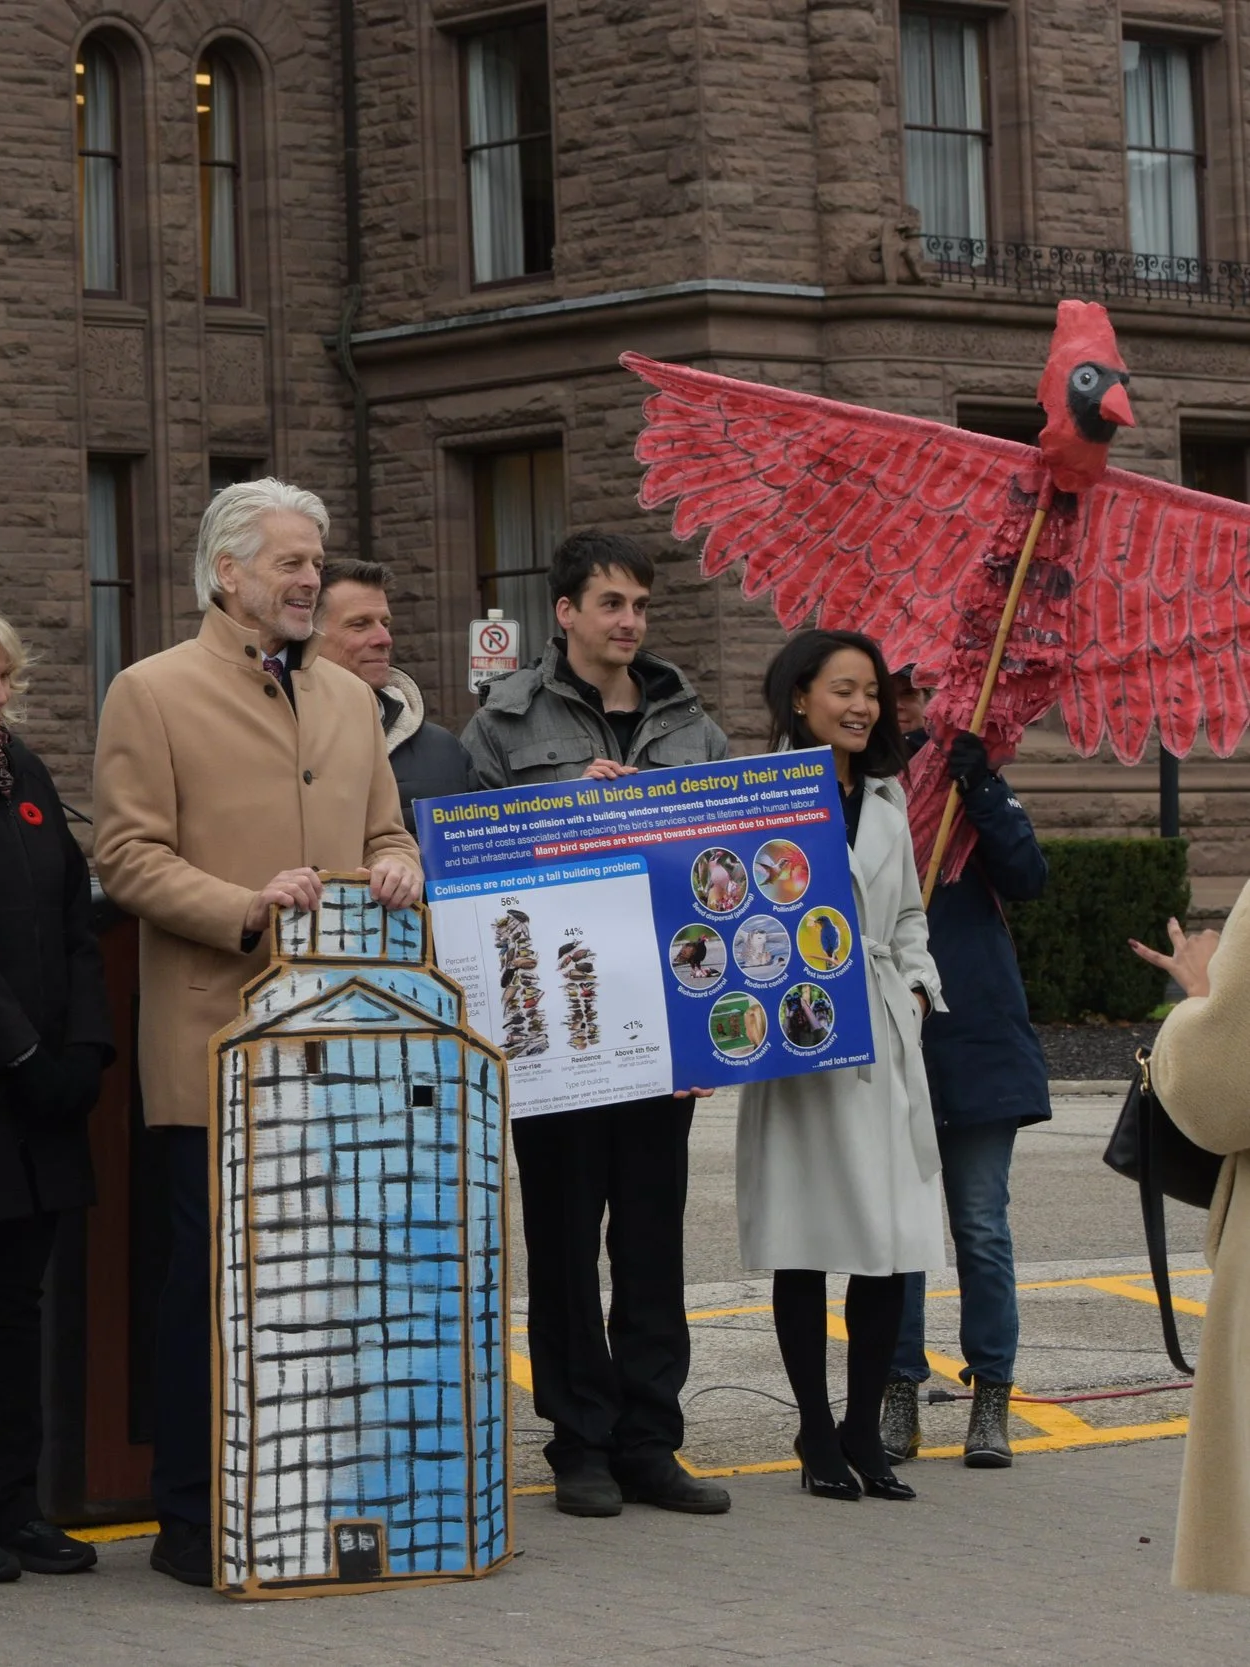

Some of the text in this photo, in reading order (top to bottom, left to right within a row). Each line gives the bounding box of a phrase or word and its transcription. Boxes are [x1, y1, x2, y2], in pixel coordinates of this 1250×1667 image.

[432, 763, 824, 824] Building windows kill birds and destroy their value
[444, 830, 465, 840] Each
[467, 827, 484, 837] bird
[485, 824, 508, 835] killed
[509, 823, 520, 833] by
[529, 816, 565, 829] collision
[567, 815, 585, 826] with
[593, 810, 626, 822] building
[628, 806, 659, 817] window
[660, 801, 704, 815] represents
[705, 795, 749, 808] thousands
[750, 793, 759, 802] of
[760, 789, 789, 800] dollars
[790, 785, 820, 796] wasted
[452, 799, 816, 853] in terms of costs associated with replacing the bird's services over its lifetime with human labour
[445, 811, 827, 868] and built infrastructure. Many bird species are trending towards extinction due to human factors.
[434, 861, 640, 896] Collisions are not only a tall building problem
[500, 896, 520, 907] 56%
[772, 902, 804, 913] Pollination
[691, 901, 705, 918] Seed
[705, 913, 734, 923] dispersal
[564, 927, 583, 937] 44%
[445, 956, 469, 966] Percent
[462, 965, 478, 973] killed
[803, 958, 854, 980] Pest insect control
[744, 972, 789, 989] Rodent control
[466, 991, 478, 999] ear
[677, 978, 728, 999] Biohazard control
[623, 1021, 643, 1031] <1%
[614, 1049, 634, 1057] Above
[645, 1045, 660, 1053] floor
[781, 1032, 838, 1057] Eco-tourism industry
[571, 1053, 601, 1064] Residence
[711, 1041, 772, 1067] Bird feeding industry
[834, 1056, 848, 1065] lots
[848, 1053, 870, 1063] more!
[514, 1063, 541, 1072] Low-rise
[565, 1081, 579, 1090] Type
[587, 1077, 610, 1086] building
